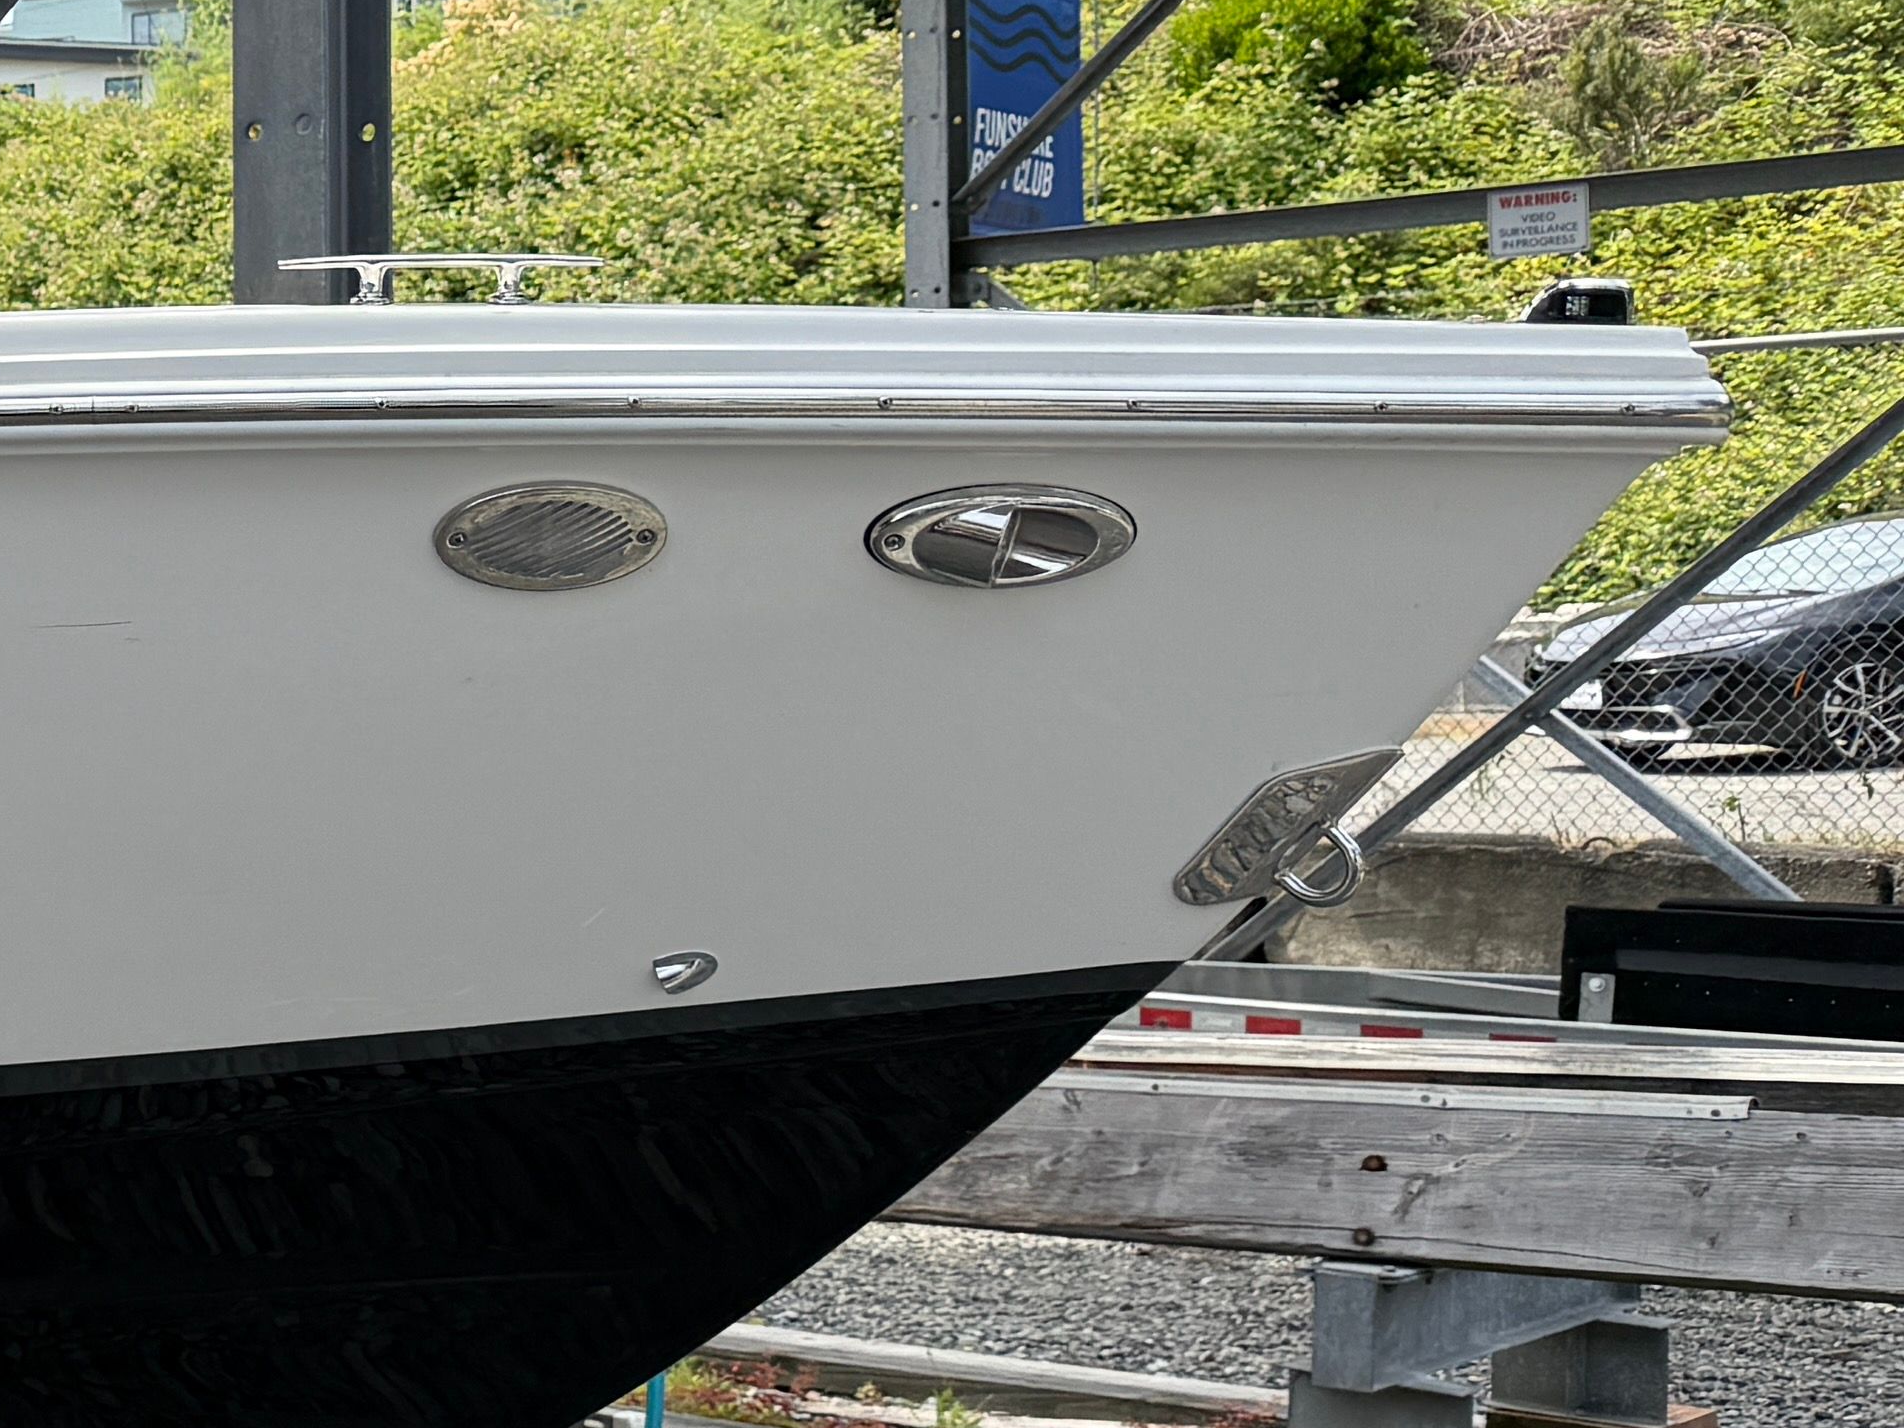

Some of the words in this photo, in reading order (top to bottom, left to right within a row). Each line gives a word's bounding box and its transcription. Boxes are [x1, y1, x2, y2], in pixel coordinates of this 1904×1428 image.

[1013, 158, 1054, 198] CLUB
[1499, 191, 1578, 210] WARNING:
[1521, 211, 1556, 223] VIDEO
[1498, 221, 1579, 238] SURVEILLANCE
[1501, 239, 1514, 250] IN
[1516, 233, 1576, 249] PROGRESS
